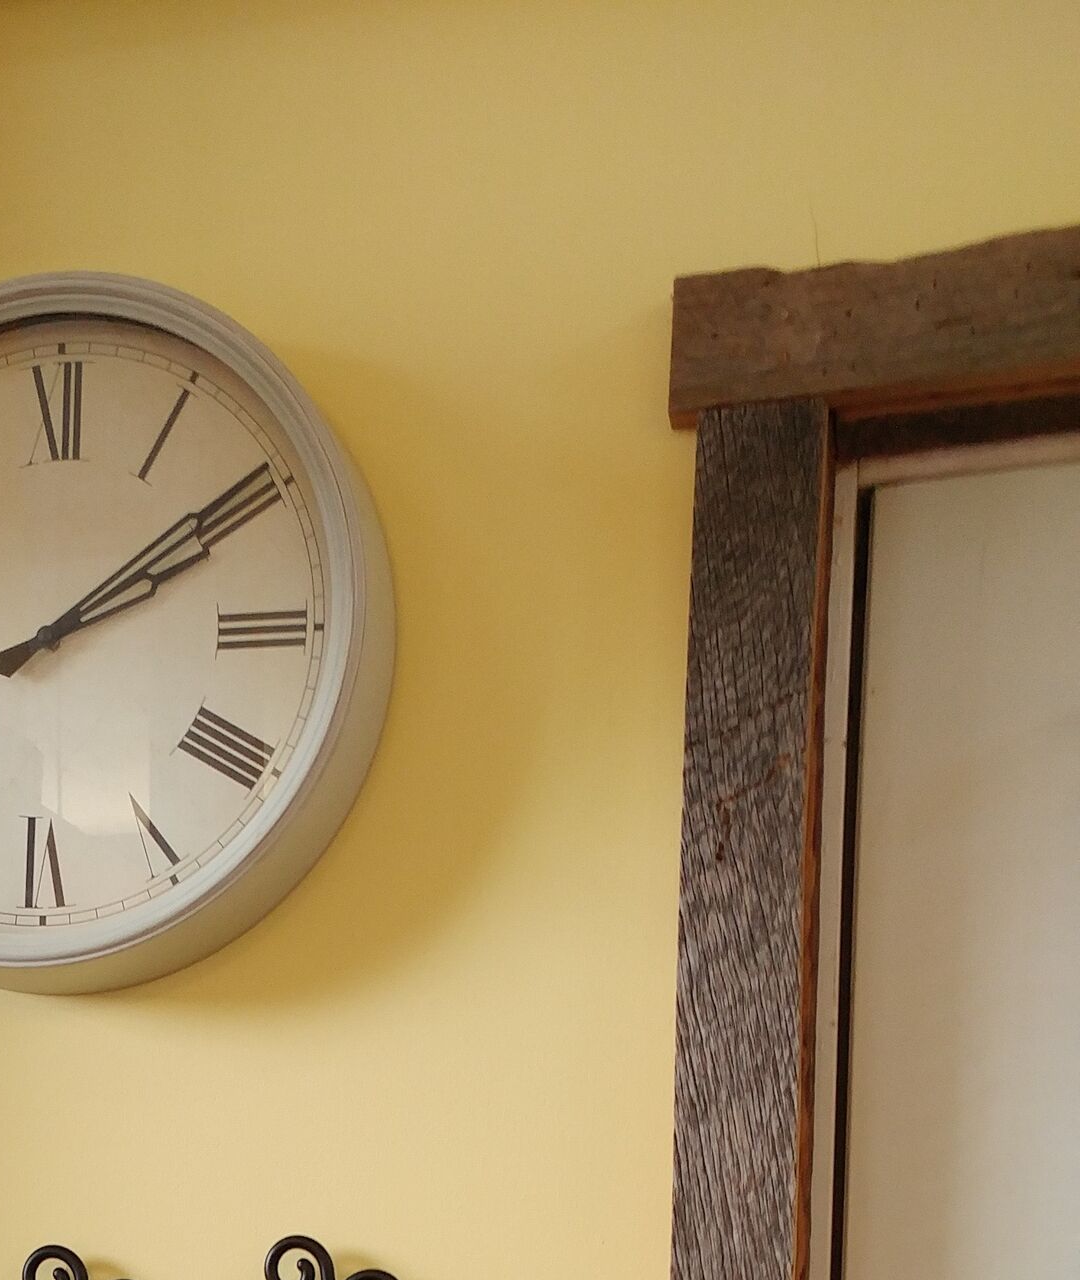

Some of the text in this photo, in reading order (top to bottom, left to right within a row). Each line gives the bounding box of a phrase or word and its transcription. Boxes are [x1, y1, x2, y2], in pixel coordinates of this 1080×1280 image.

[22, 360, 97, 467] XII
[215, 599, 308, 661] III
[16, 815, 76, 910] VI
